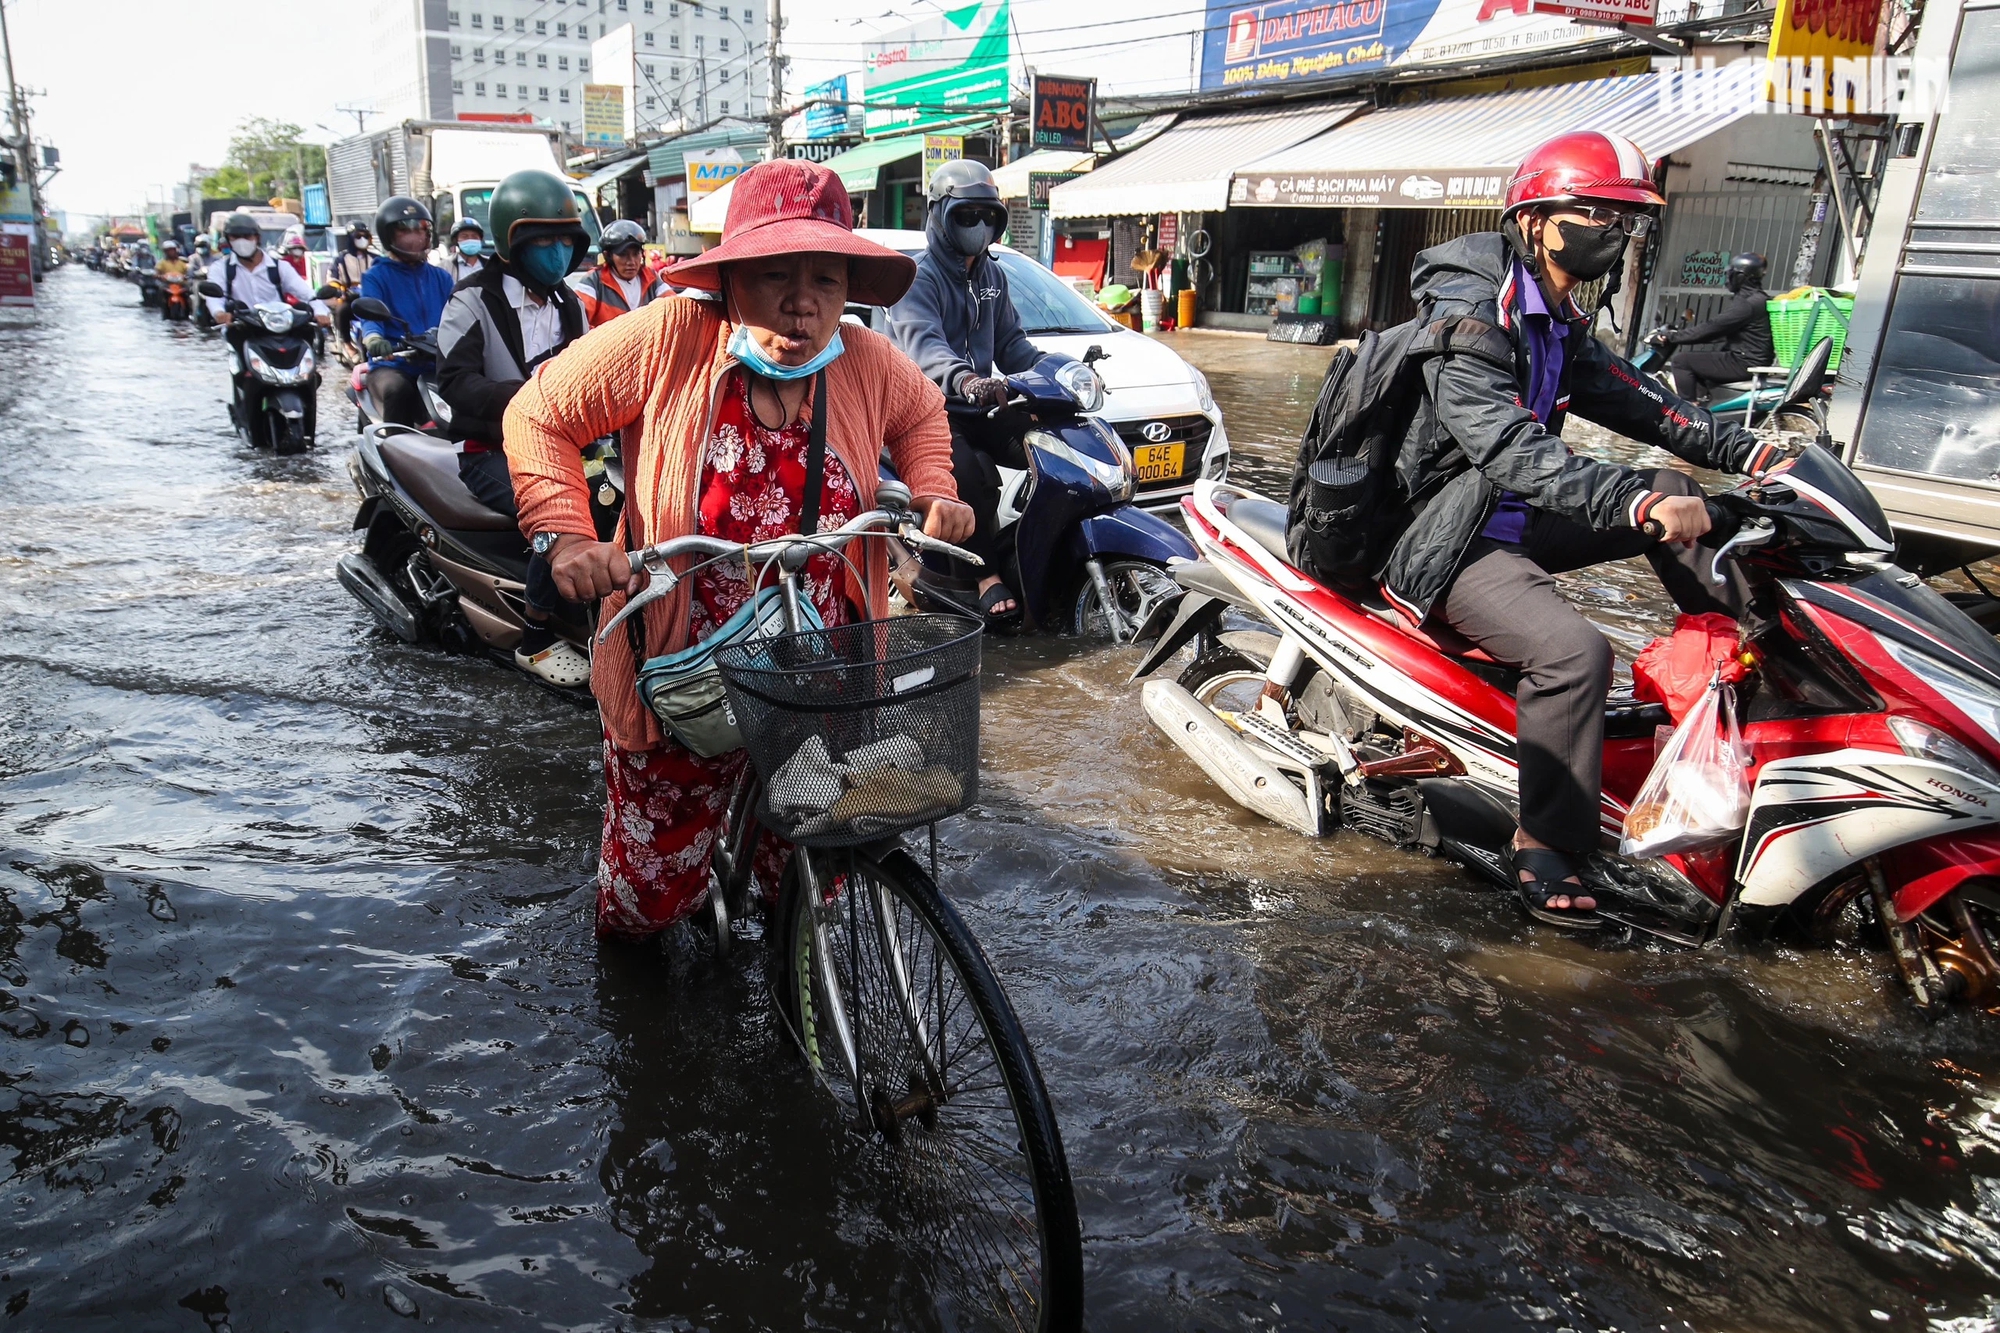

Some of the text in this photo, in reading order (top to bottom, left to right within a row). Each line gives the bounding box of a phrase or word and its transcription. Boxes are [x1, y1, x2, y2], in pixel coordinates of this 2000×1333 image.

[1262, 0, 1382, 44] DAPHACO
[876, 45, 907, 68] Castrol
[1037, 99, 1086, 130] ABC
[1049, 132, 1062, 145] LED
[793, 145, 852, 161] DUHA
[926, 146, 961, 160] CƠM CHAY
[1296, 176, 1315, 193] PHÊ
[1346, 178, 1367, 193] PHA
[1369, 175, 1397, 193] MÁY
[1608, 363, 1640, 388] TOYOTA
[1148, 446, 1171, 463] 64E
[1925, 776, 1989, 809] HONDA
